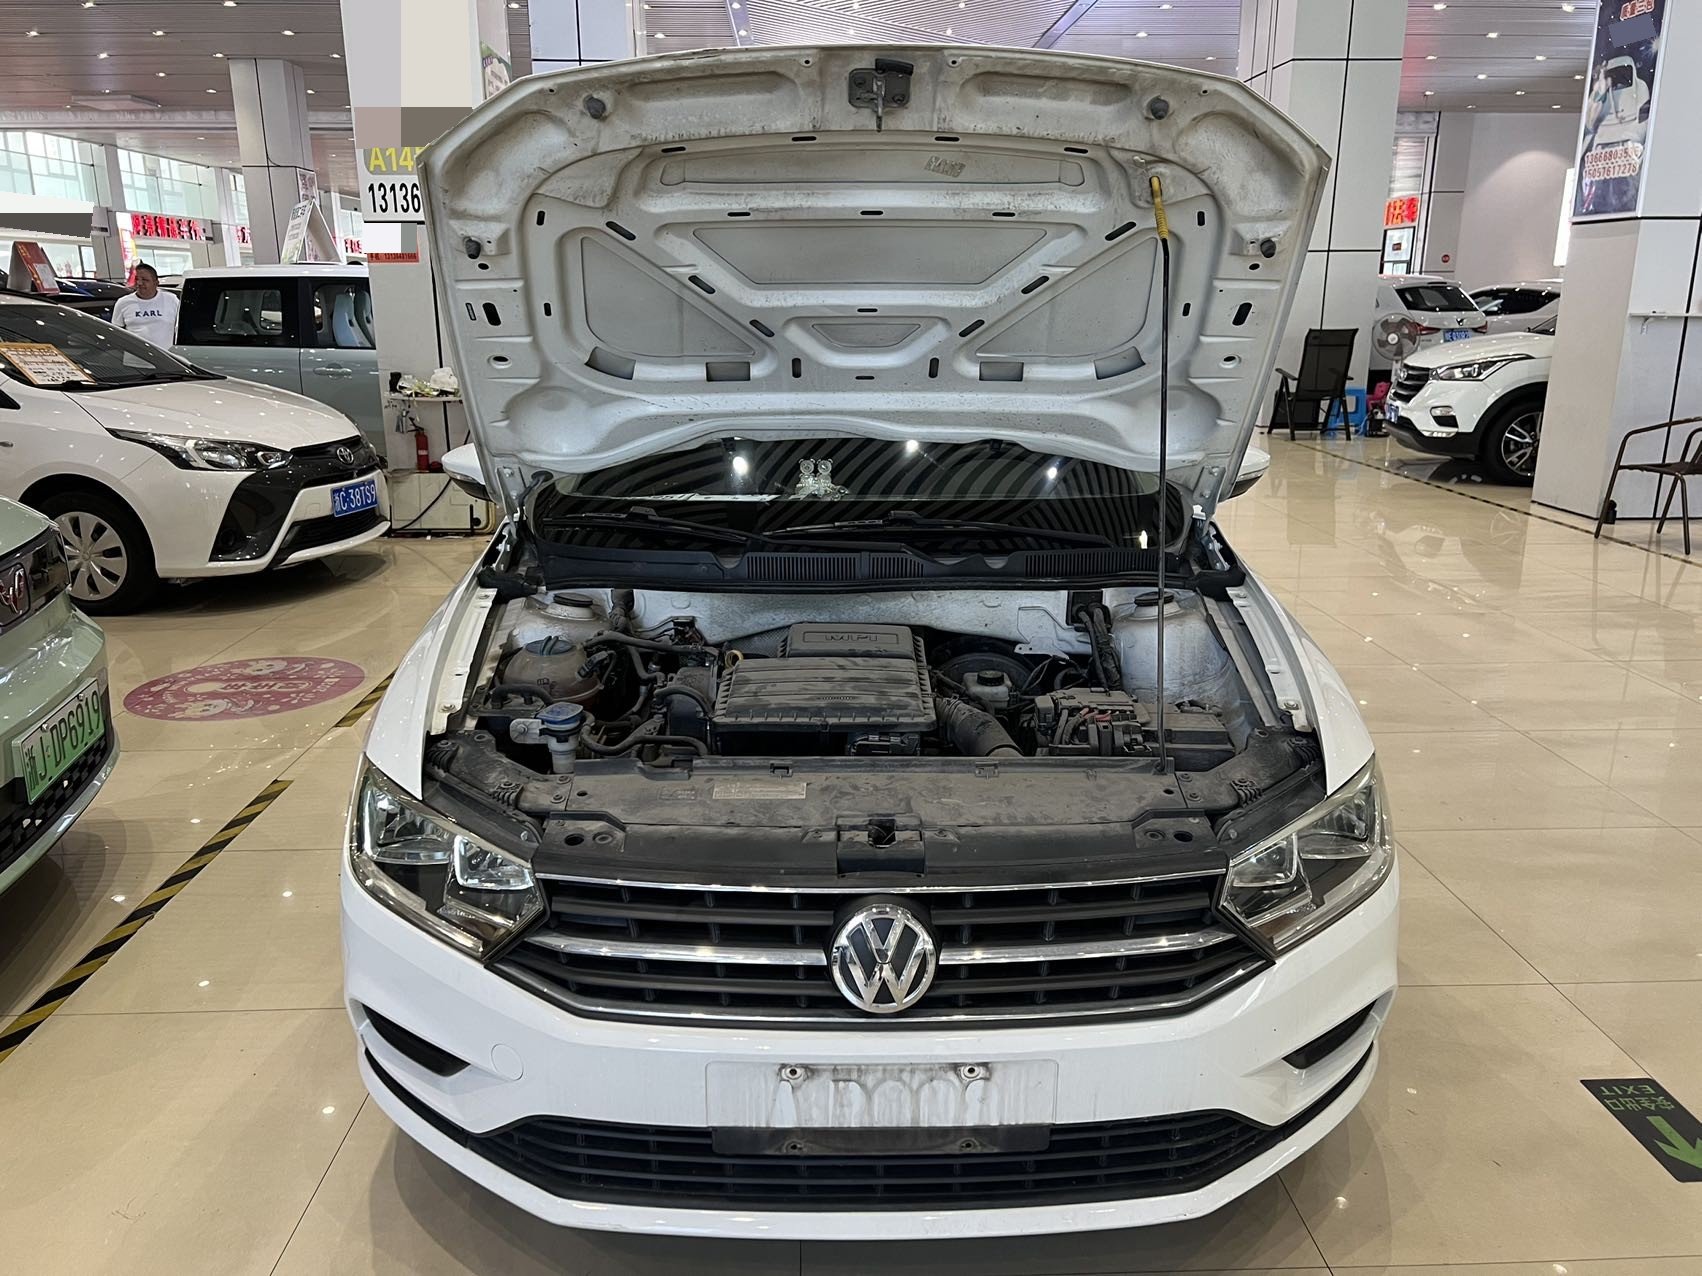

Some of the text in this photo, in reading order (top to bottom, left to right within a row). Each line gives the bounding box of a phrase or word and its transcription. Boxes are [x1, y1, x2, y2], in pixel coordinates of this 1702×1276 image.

[135, 310, 163, 318] KARL
[1601, 1084, 1656, 1096] EXIT
[1604, 1096, 1675, 1111] 安全出口
